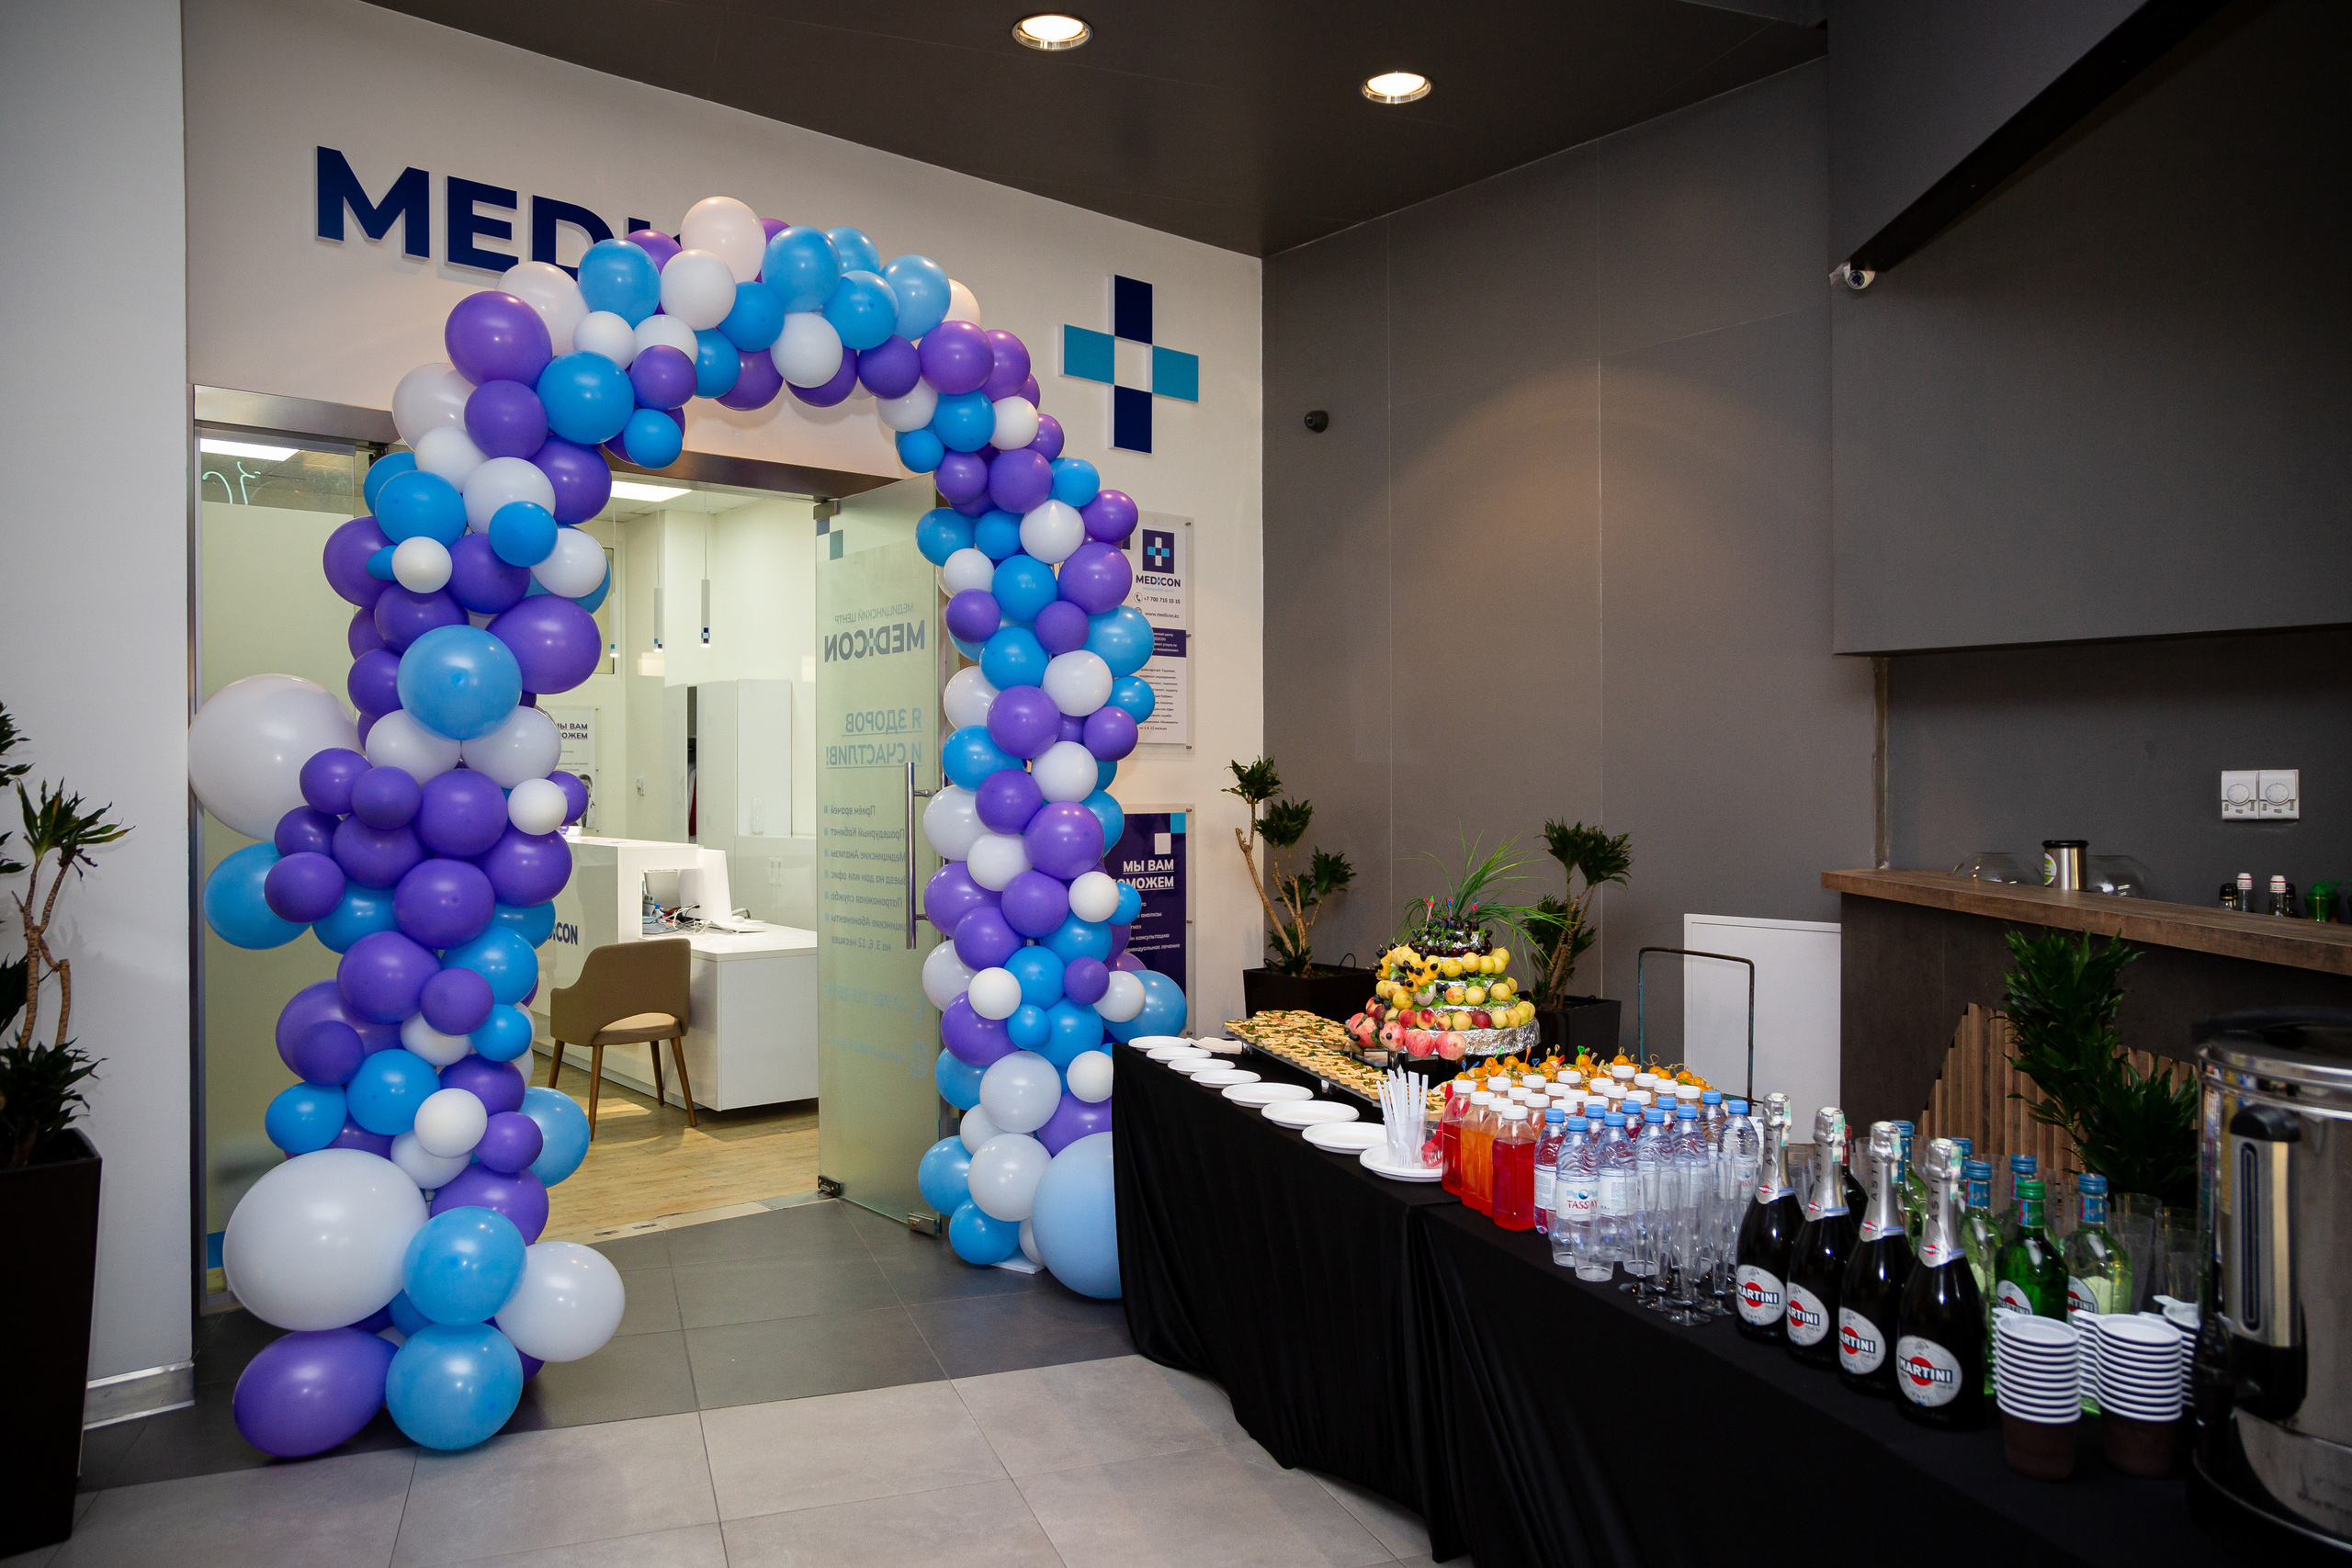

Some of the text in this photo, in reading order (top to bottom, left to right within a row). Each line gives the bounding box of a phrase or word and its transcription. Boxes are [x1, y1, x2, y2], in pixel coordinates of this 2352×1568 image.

[316, 145, 682, 280] MED
[1136, 575, 1182, 588] MEDICON
[1123, 859, 1174, 873] МЫ ВАМ
[1113, 876, 1174, 890] МОЖЕМ
[1764, 1128, 1773, 1167] ASTI
[1871, 1159, 1879, 1201] ASTI
[1931, 1179, 1940, 1224] ASTI
[1787, 1304, 1818, 1325] ARTINI
[1900, 1359, 1951, 1382] MARTINI
